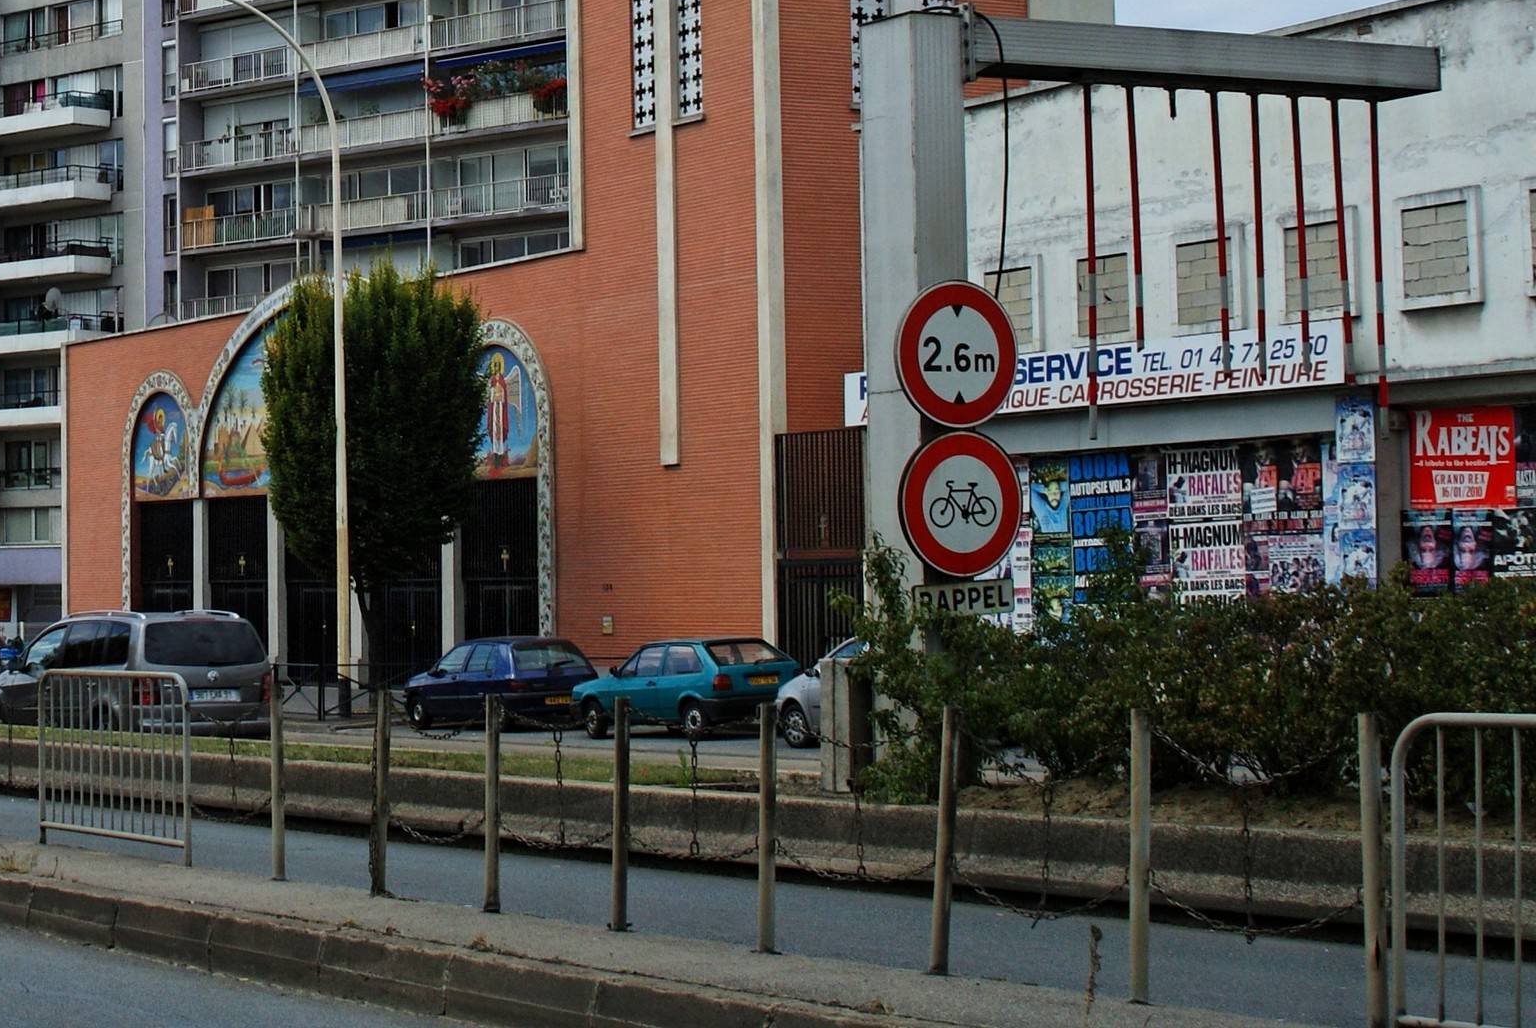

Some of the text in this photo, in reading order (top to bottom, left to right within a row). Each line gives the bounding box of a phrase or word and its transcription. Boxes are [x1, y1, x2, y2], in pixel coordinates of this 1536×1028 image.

[923, 336, 995, 372] 2.6m
[1014, 347, 1133, 385] SERVCE
[1142, 351, 1172, 373] TEL.
[1181, 347, 1204, 369] 01
[1270, 338, 1296, 360] 25
[1456, 413, 1474, 423] THE
[1415, 411, 1510, 465] RABEATS
[1168, 449, 1238, 475] H-MAGNUM
[1070, 479, 1131, 497] AUTOPSIE VOL.3
[1188, 472, 1242, 496] RAFALES
[1434, 473, 1486, 485] GRAND REX
[1187, 504, 1207, 517] DANS
[1208, 504, 1220, 516] LES
[1221, 503, 1242, 516] BACS
[1171, 524, 1243, 549] H-MAGNUM
[1191, 547, 1245, 571] RAFALES
[1190, 579, 1209, 591] DANS
[1211, 578, 1224, 590] LES
[1225, 578, 1245, 590] BACS
[919, 584, 1010, 613] RAPPEL
